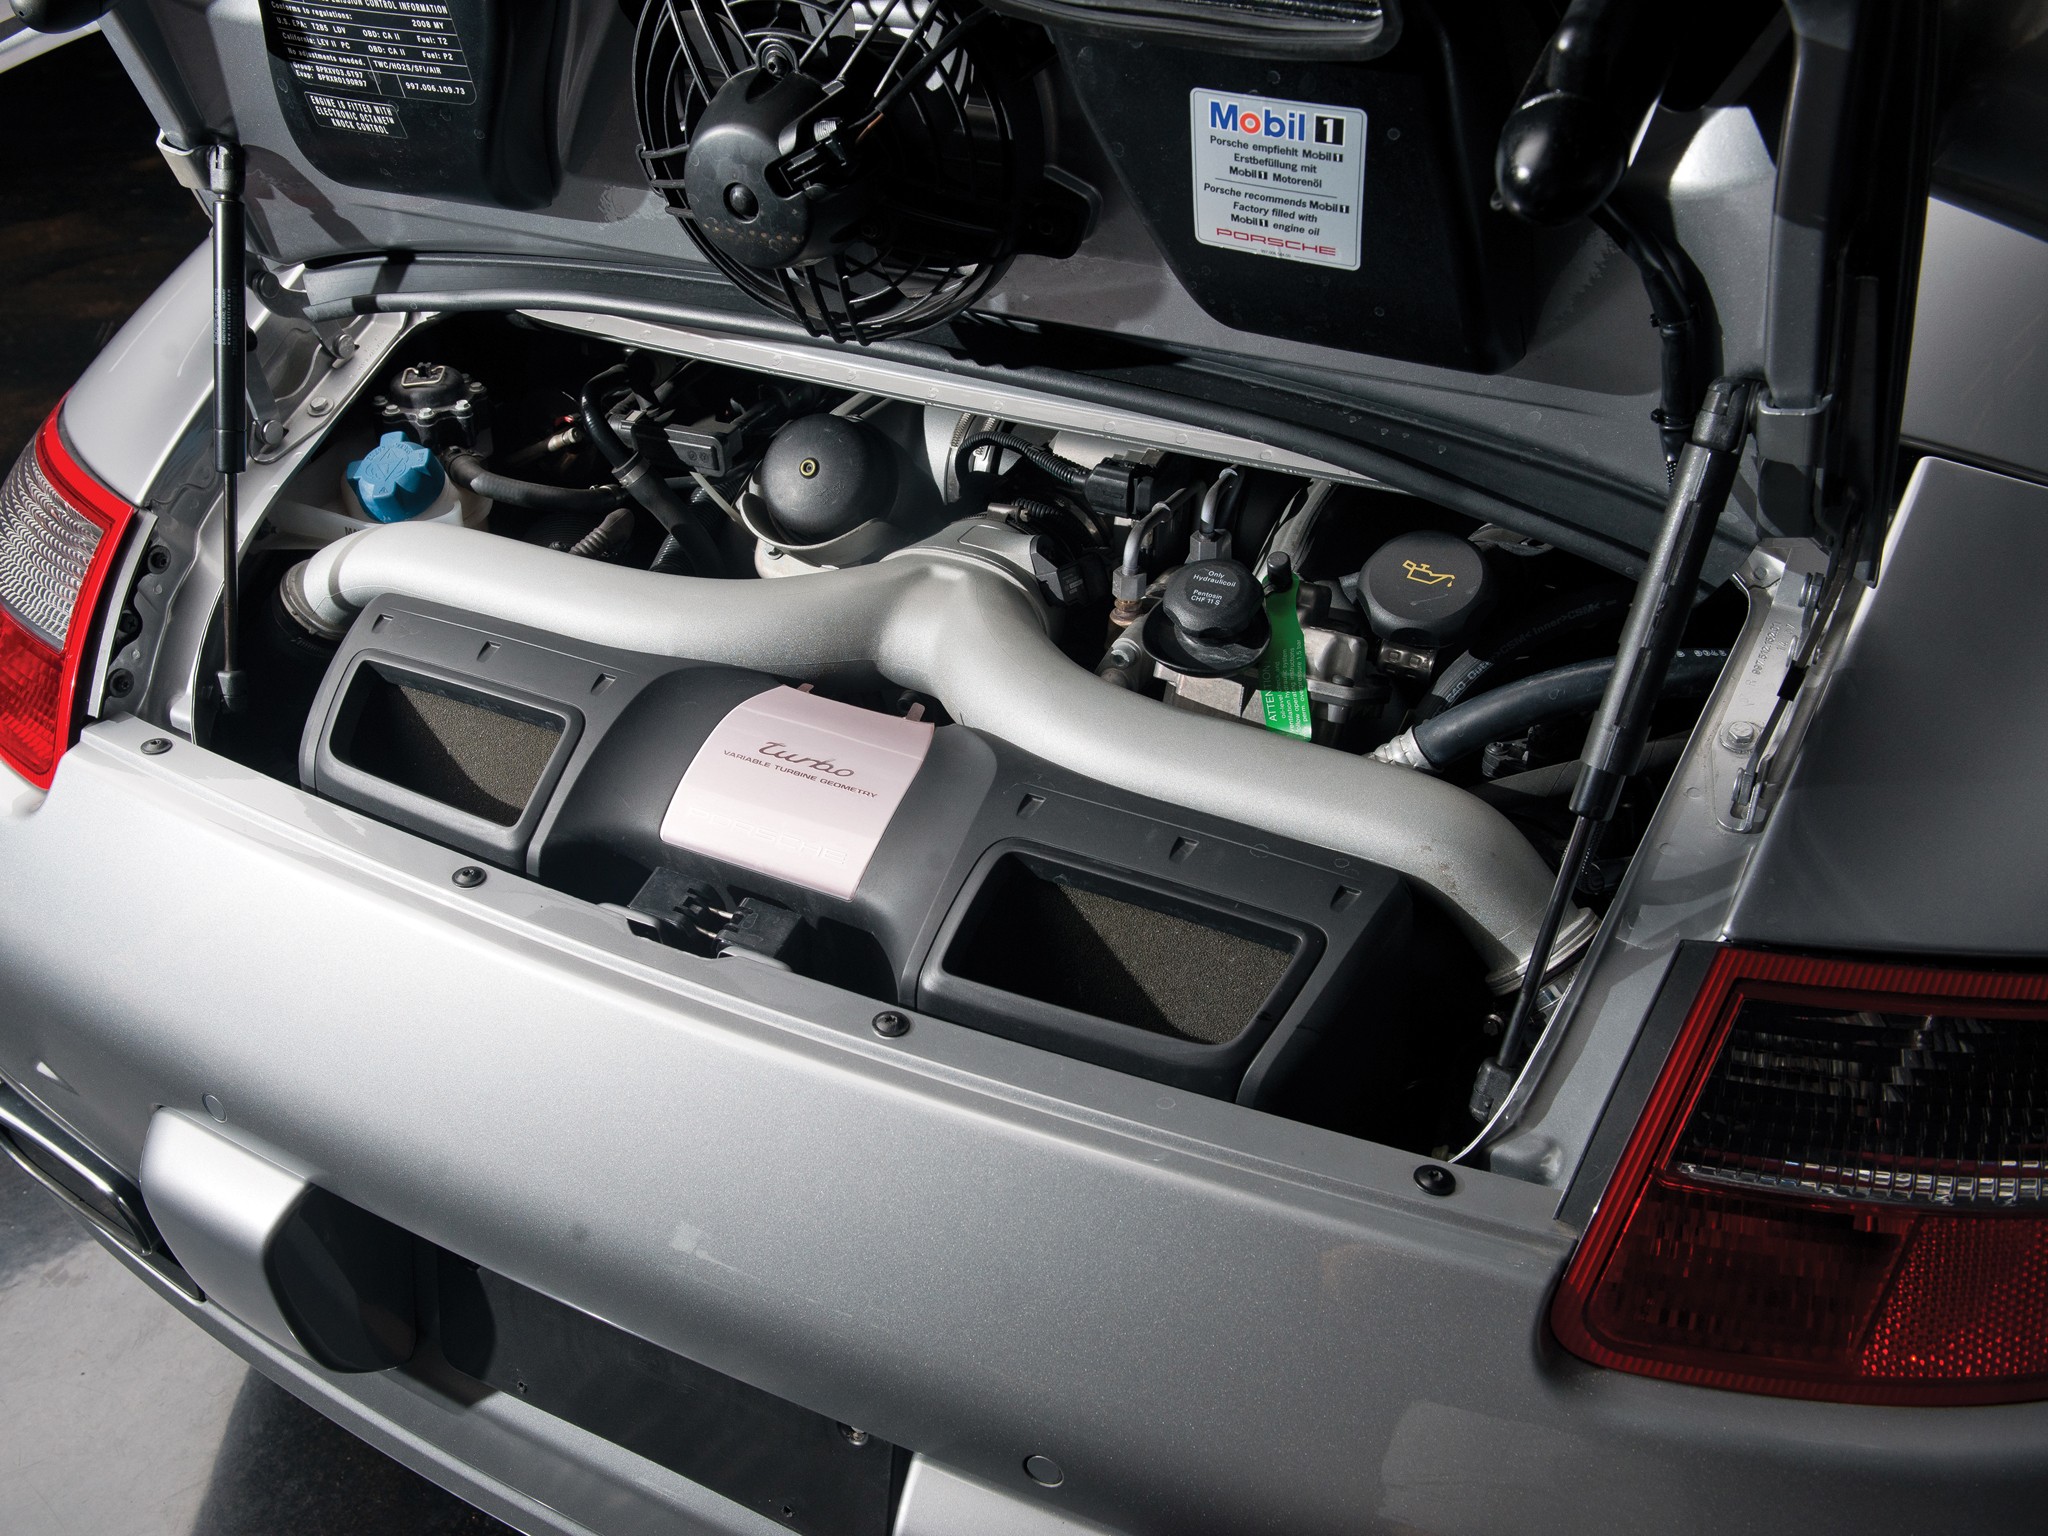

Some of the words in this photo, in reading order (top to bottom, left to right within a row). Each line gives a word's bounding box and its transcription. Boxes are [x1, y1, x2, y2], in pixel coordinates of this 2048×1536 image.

[271, 1, 301, 13] Conforms
[311, 9, 353, 20] regulations:
[366, 0, 397, 10] CONTROL
[400, 2, 448, 14] INFORMATION
[276, 17, 290, 26] U.S.
[292, 20, 308, 29] EPA:
[332, 25, 346, 34] LDV
[362, 29, 381, 39] OBD:
[382, 31, 393, 40] CA
[416, 35, 436, 44] Fuel:
[437, 37, 448, 45] T2
[411, 19, 431, 29] 2008
[433, 21, 444, 29] MY
[282, 32, 316, 44] California:
[316, 38, 330, 46] LEV
[340, 41, 351, 50] PC
[367, 45, 386, 54] OBD:
[388, 47, 399, 56] CA
[421, 51, 441, 60] Fuel:
[442, 52, 454, 61] P2
[287, 47, 296, 55] No
[298, 50, 337, 62] adjustments
[338, 56, 366, 66] needed.
[292, 61, 314, 72] Group:
[295, 70, 314, 79] Evap:
[405, 81, 466, 95] 997.006.109.73
[309, 95, 337, 108] ENGINE
[337, 99, 346, 109] IS
[346, 101, 372, 113] FITTED
[373, 105, 393, 116] WITH
[314, 105, 358, 121] ELECTRONIC
[331, 118, 355, 129] KNOCK
[355, 123, 389, 135] CONTROL
[1209, 99, 1306, 141] Mobil
[1210, 135, 1249, 150] Porsche
[1252, 145, 1298, 157] empfiehlt
[1234, 153, 1297, 172] Erstbefüllung
[1301, 163, 1317, 174] mit
[1272, 173, 1322, 189] Motorenöl
[1204, 183, 1242, 197] Porsche
[1244, 192, 1307, 208] recommends
[1233, 201, 1269, 217] Factory
[1271, 207, 1295, 220] filled
[1298, 213, 1318, 223] with
[1273, 222, 1305, 235] engine
[1308, 226, 1320, 236] oil
[1216, 228, 1336, 256] PORSCHE
[1193, 574, 1237, 588] Hydraulicoil
[1208, 570, 1225, 579] Only
[1193, 588, 1223, 600] Pentosin
[1262, 665, 1278, 722] ATTENTION
[1290, 682, 1300, 712] operating
[1278, 694, 1287, 719] oil-level
[1286, 700, 1295, 732] ventilation
[758, 741, 854, 777] turbo
[723, 749, 771, 768] VARIABLE
[774, 764, 817, 781] TURBINE
[819, 778, 878, 798] GEOMETRY
[688, 806, 848, 864] PORSCHE
